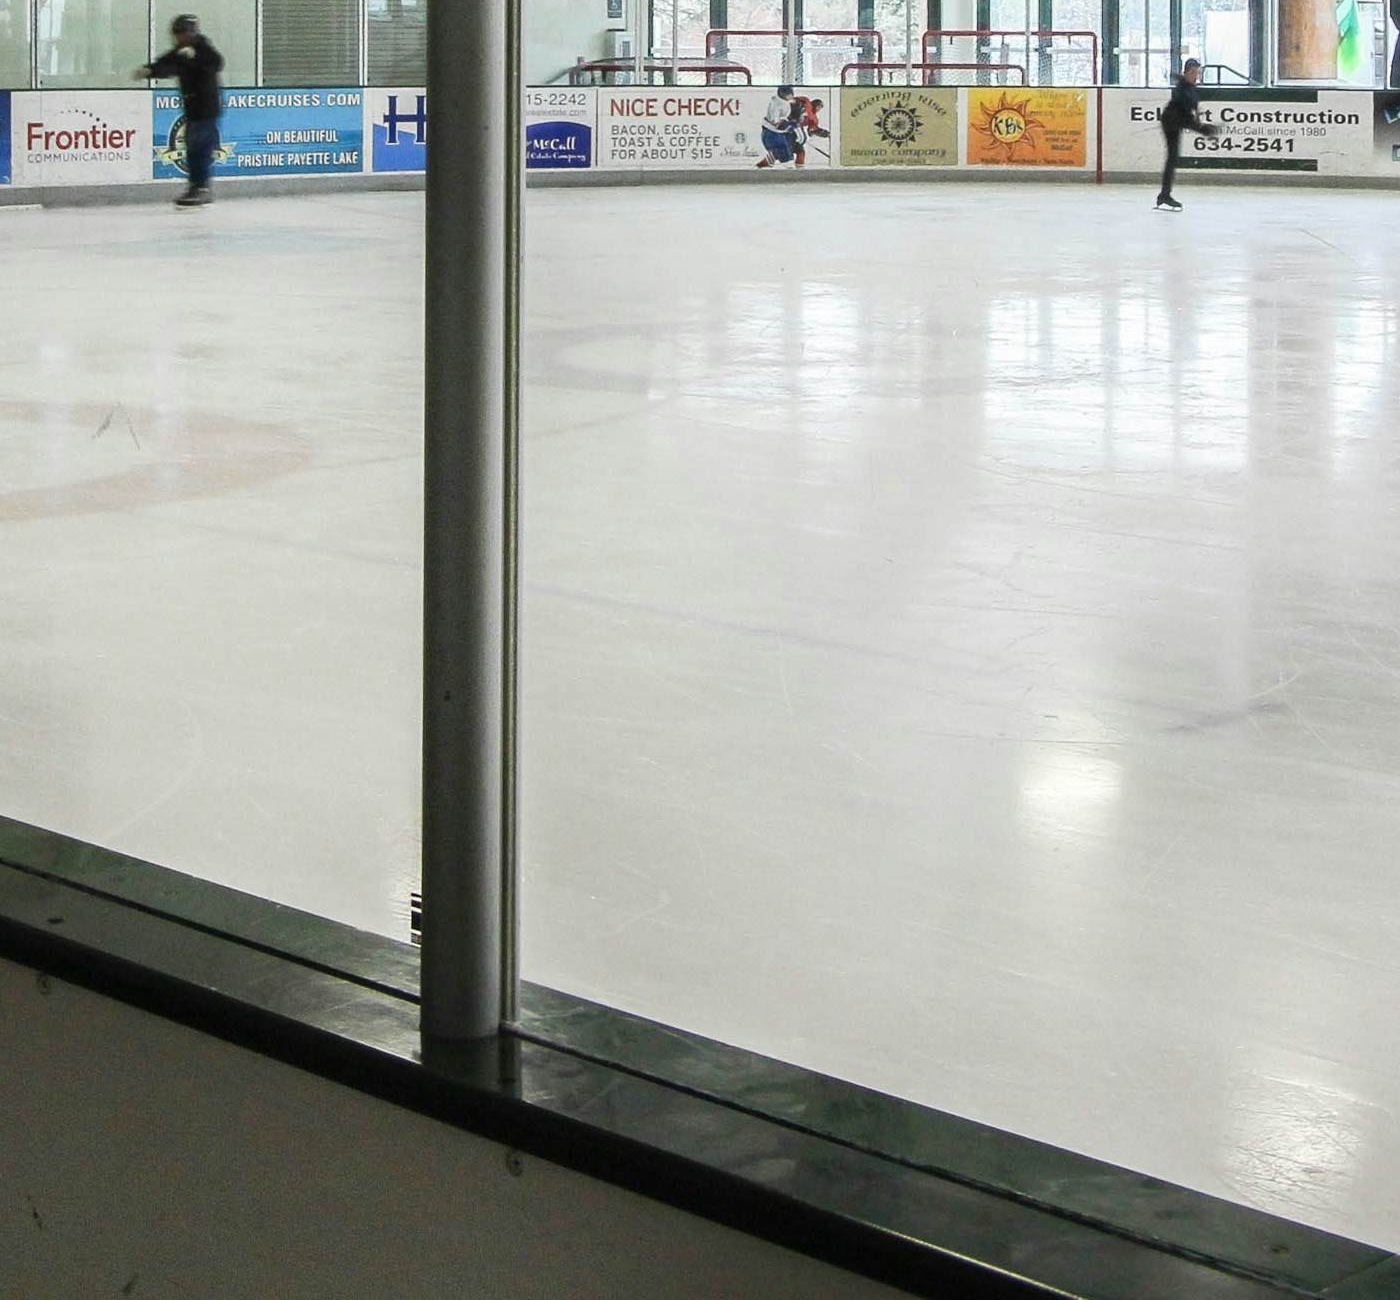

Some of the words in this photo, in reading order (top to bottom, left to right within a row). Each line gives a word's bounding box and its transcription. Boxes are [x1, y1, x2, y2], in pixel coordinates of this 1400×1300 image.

[609, 98, 659, 117] NICE
[663, 97, 741, 117] CHECK!
[1220, 107, 1360, 125] Construction
[26, 122, 136, 151] Frontier
[284, 129, 339, 144] BEAUTIFUL
[610, 124, 661, 136] BACON,
[664, 124, 703, 136] EGGS,
[1226, 126, 1265, 135] McCall
[1267, 126, 1296, 136] since
[1300, 127, 1327, 137] 1980
[532, 135, 577, 151] McCall
[610, 136, 654, 148] TOAST
[656, 137, 666, 148] &
[669, 136, 721, 148] COFFEE
[1193, 136, 1295, 153] 634-2541
[27, 151, 132, 164] COMMUNICATIONS
[237, 154, 285, 168] PRISTINE
[287, 152, 330, 167] PAYETTE
[332, 151, 359, 165] LAKE
[610, 149, 637, 160] FOR
[640, 148, 687, 160] ABOUT
[690, 147, 714, 161] $15
